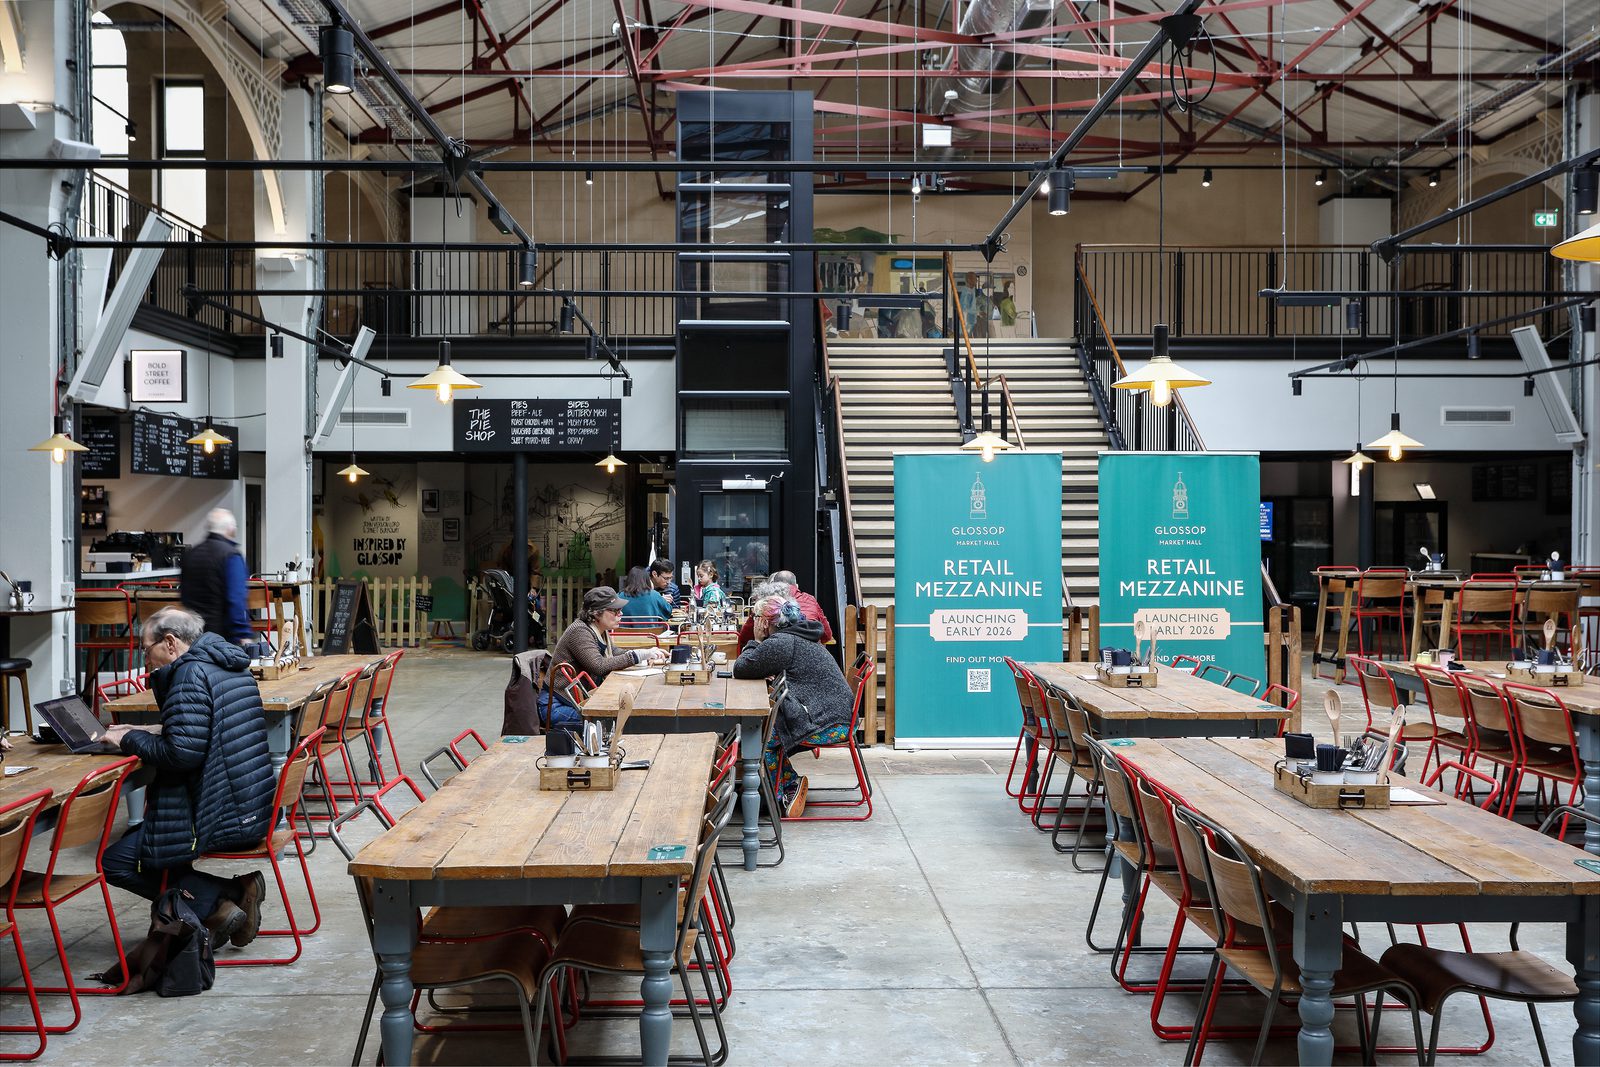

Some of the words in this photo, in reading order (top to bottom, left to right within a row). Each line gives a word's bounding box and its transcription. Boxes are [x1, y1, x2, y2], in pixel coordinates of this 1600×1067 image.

[511, 400, 528, 409] PIES
[567, 400, 590, 409] SIDES
[468, 408, 491, 420] THE
[531, 409, 543, 417] ALE
[567, 409, 592, 418] BUTTERY
[593, 409, 607, 418] MASH
[470, 419, 491, 431] PIE
[465, 430, 496, 441] SHOP
[951, 526, 1005, 535] GLOSSOP
[1154, 526, 1207, 535] GLOSSOP
[353, 538, 394, 551] INSPIRED
[396, 538, 407, 551] BY
[357, 552, 403, 566] GLOSSOP
[944, 559, 1014, 576] RETAIL
[1147, 559, 1216, 575] RETAIL
[915, 581, 1043, 597] MEZZANINE
[1119, 580, 1245, 597] MEZZANINE
[941, 614, 1016, 624] LAUNCHING
[1145, 613, 1219, 623] LAUNCHING
[946, 626, 982, 636] EARLY
[986, 626, 1012, 636] 2026
[1150, 625, 1185, 635] ARLY
[1190, 625, 1215, 635] 2026
